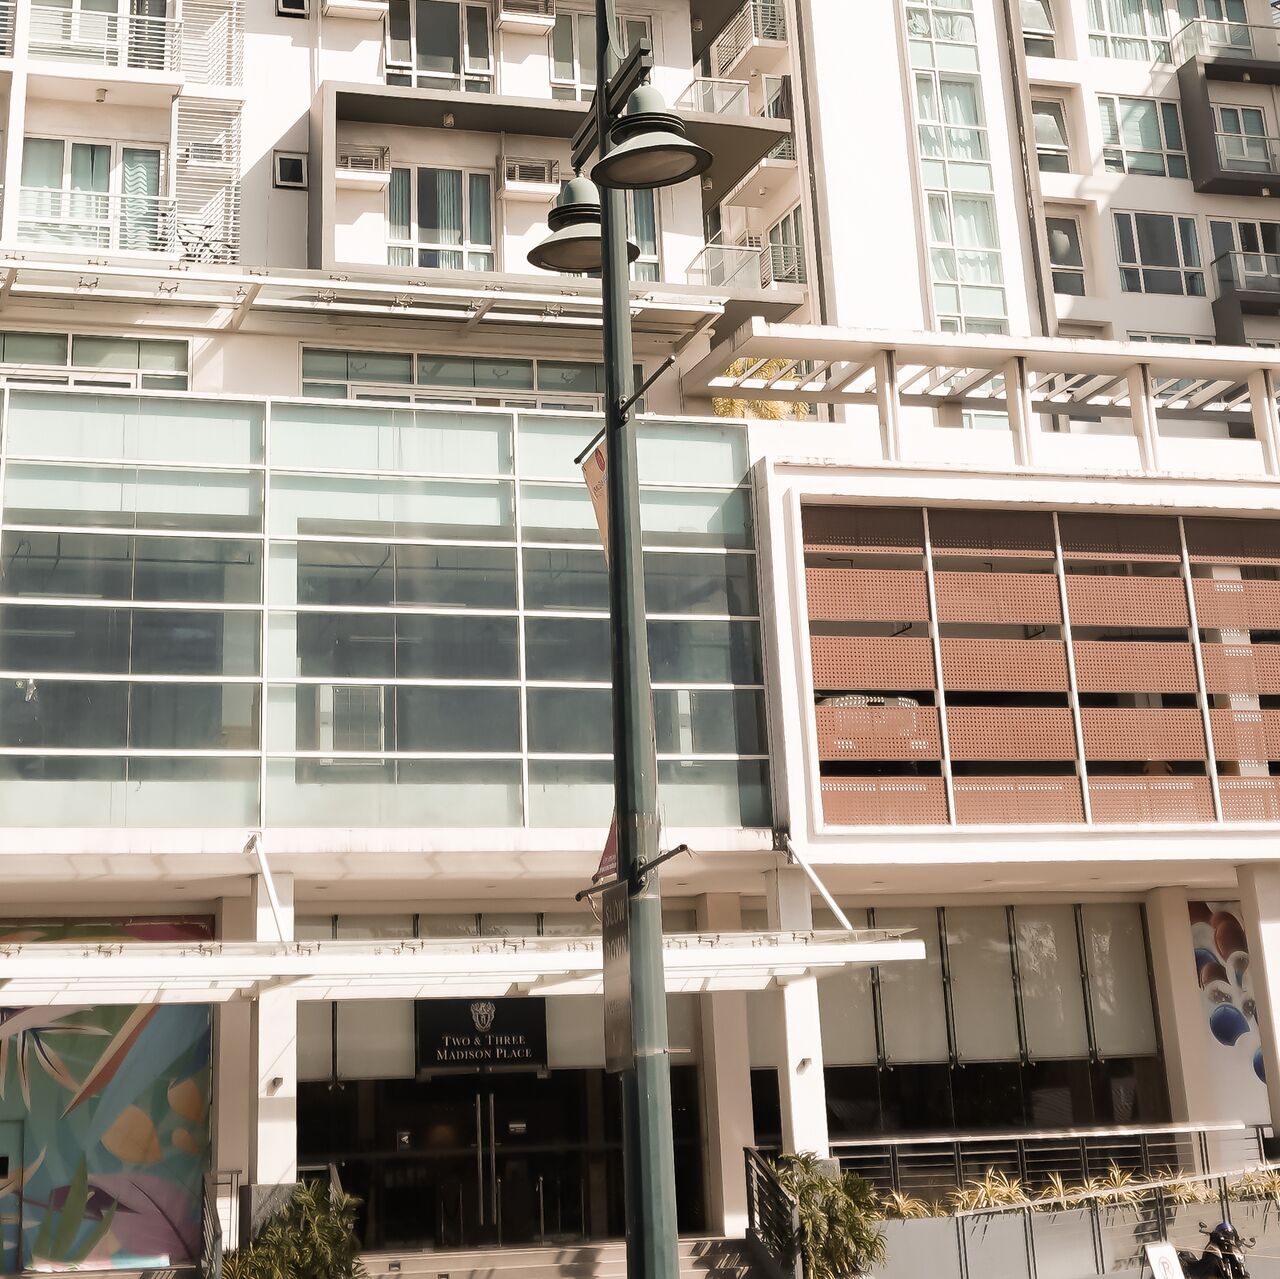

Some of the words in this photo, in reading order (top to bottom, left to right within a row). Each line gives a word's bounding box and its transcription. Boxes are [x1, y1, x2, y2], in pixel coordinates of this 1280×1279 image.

[605, 898, 625, 927] SLOW
[605, 934, 627, 960] DOWN
[442, 1035, 471, 1047] TWO
[473, 1037, 481, 1046] &
[485, 1034, 526, 1046] THREE
[436, 1049, 492, 1061] MADISON
[496, 1047, 532, 1059] PLACE
